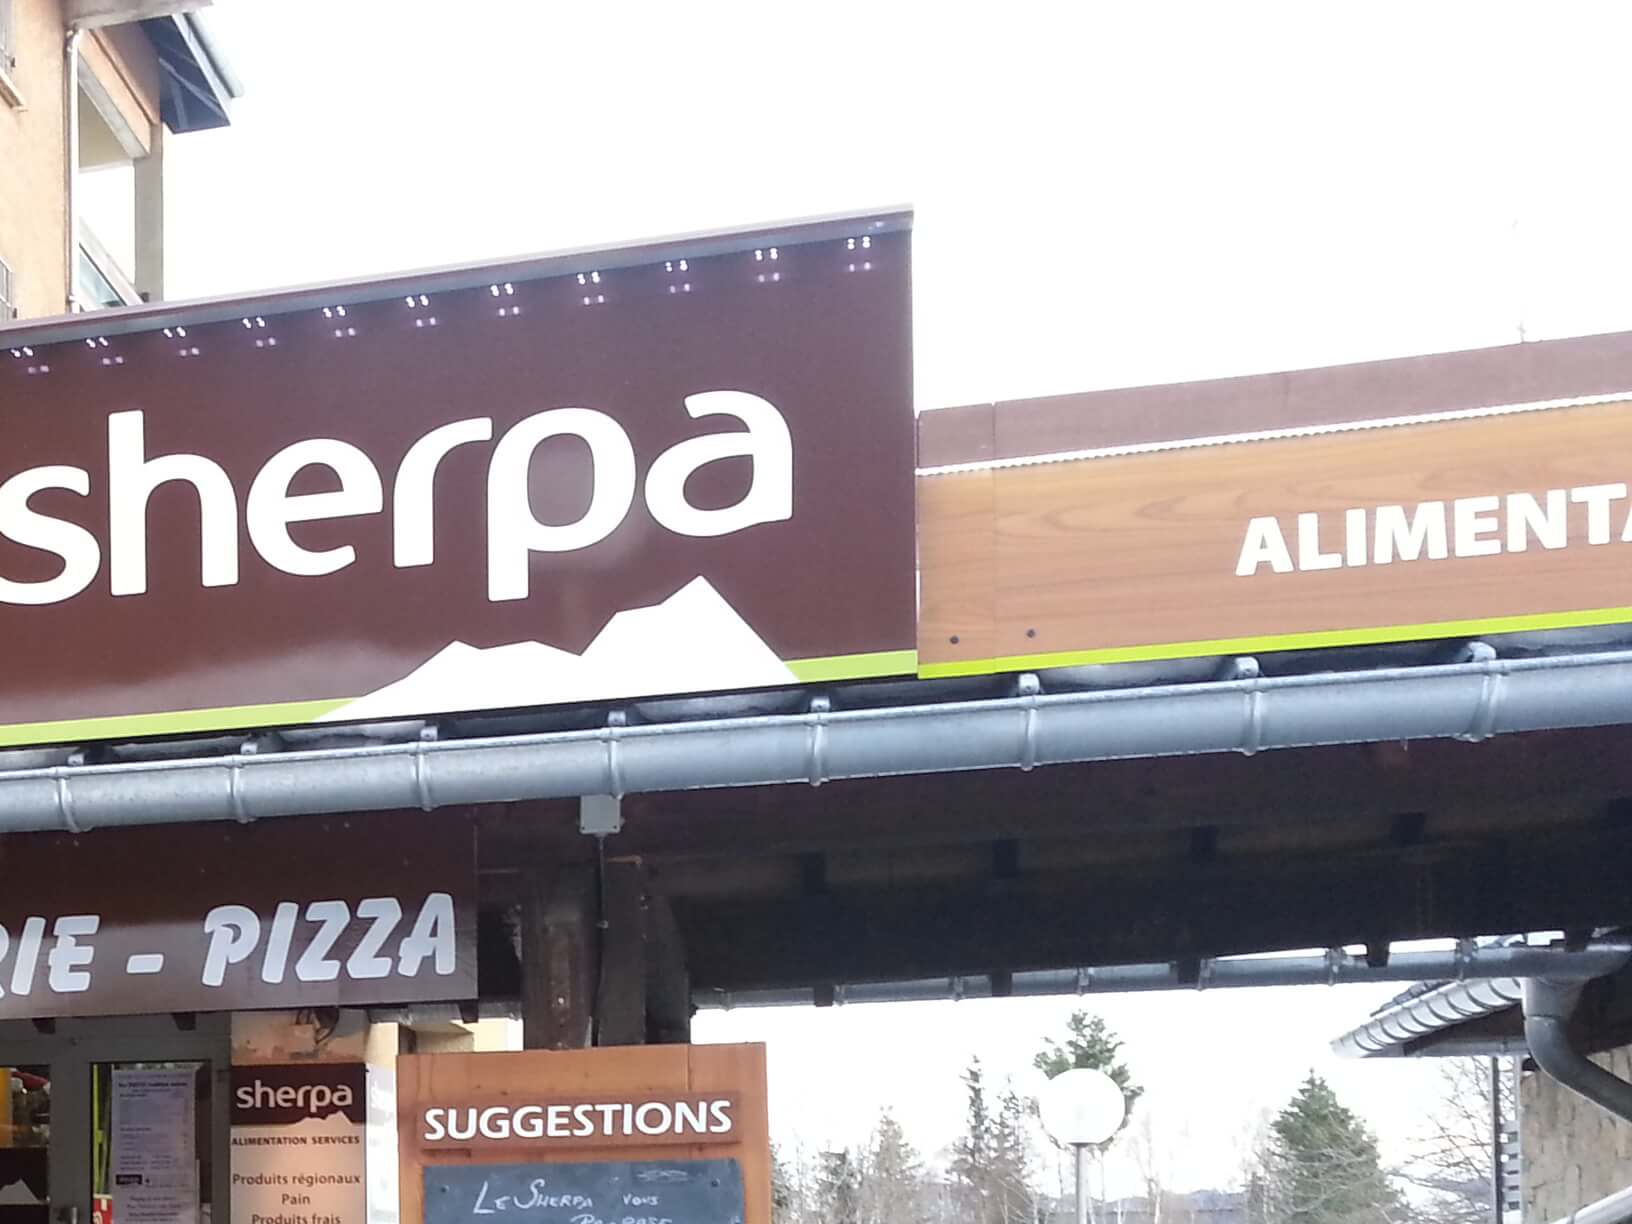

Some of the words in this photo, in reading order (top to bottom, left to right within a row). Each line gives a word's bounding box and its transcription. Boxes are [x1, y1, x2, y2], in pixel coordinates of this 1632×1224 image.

[1235, 483, 1632, 576] ALIMENT
[202, 892, 456, 987] PIZZA
[236, 1080, 353, 1112] sherpa
[424, 1100, 732, 1140] SUGGESTIONS
[231, 1136, 307, 1146] ALIMENTATION
[311, 1135, 360, 1145] SERVICES
[232, 1173, 288, 1185] Produits
[292, 1173, 361, 1188] régionaux
[281, 1193, 311, 1205] Pain
